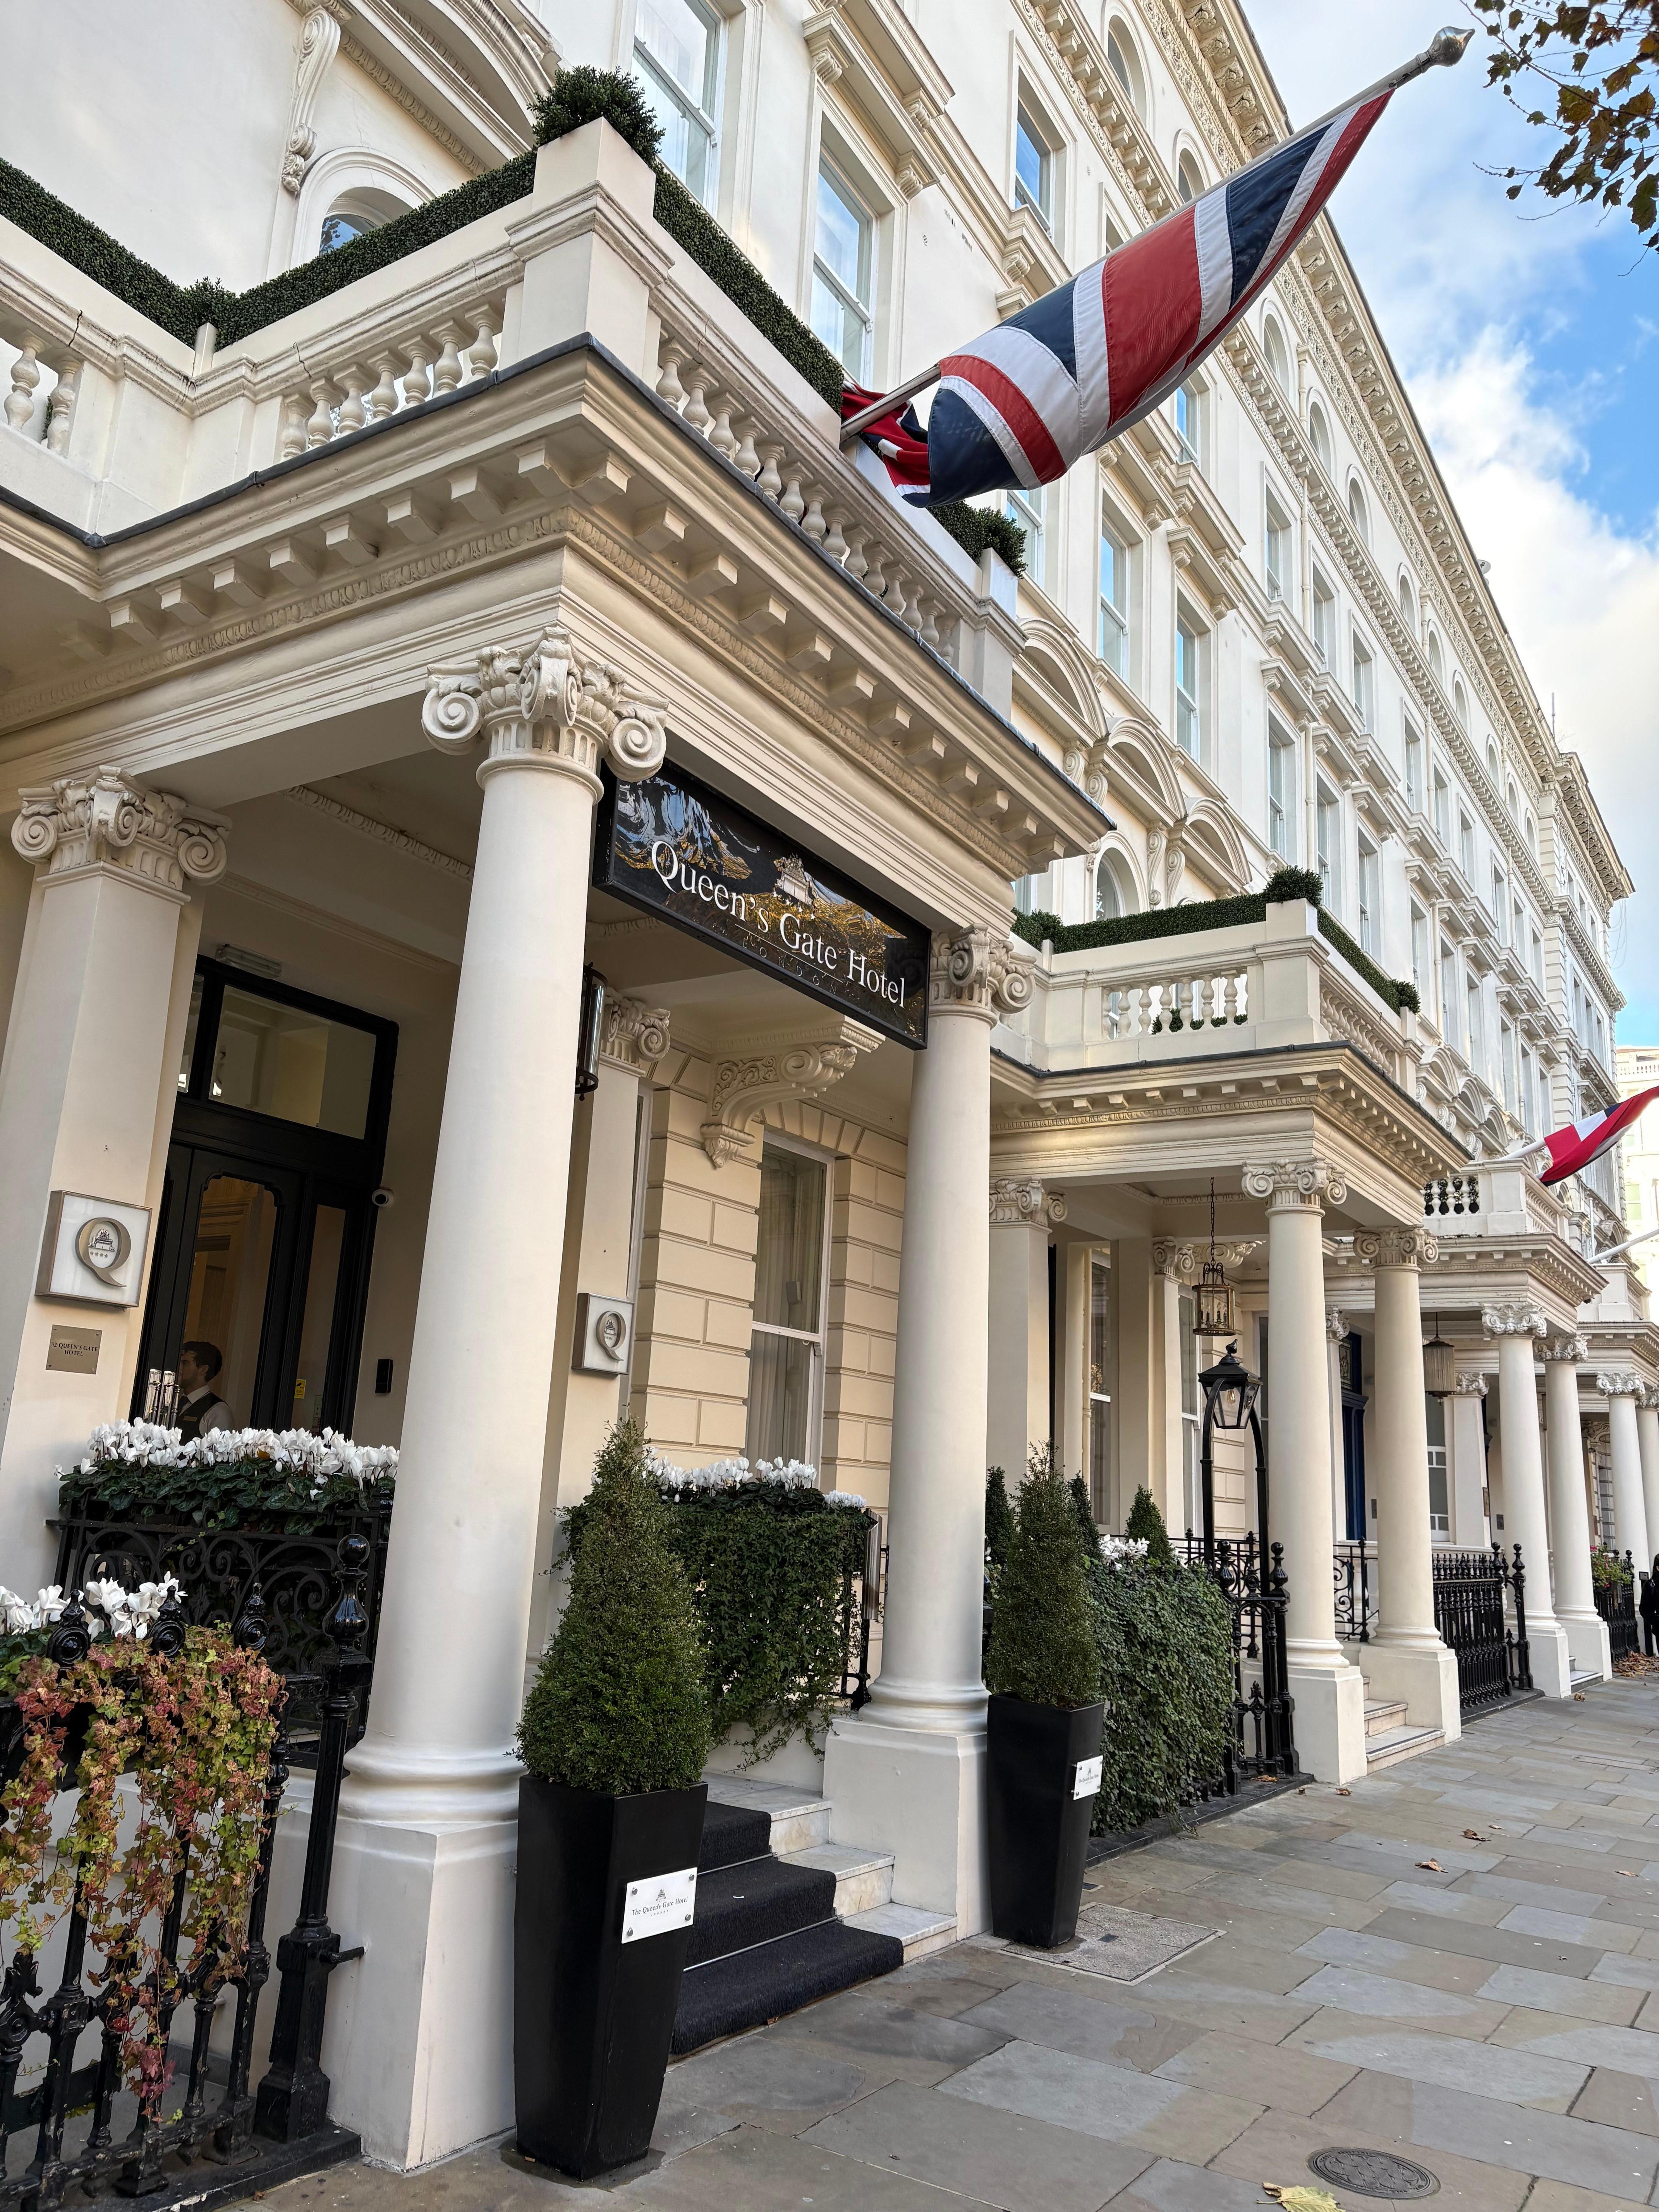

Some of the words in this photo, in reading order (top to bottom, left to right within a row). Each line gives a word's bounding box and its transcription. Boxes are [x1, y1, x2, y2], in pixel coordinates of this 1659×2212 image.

[652, 841, 768, 933] Queen's
[780, 913, 837, 969] Gate
[847, 947, 905, 1009] Hotel
[743, 938, 836, 994] LONDON
[75, 1217, 131, 1287] Q
[596, 1310, 626, 1361] Q
[643, 1904, 661, 1914] Queen's
[675, 1896, 688, 1905] Hotel
